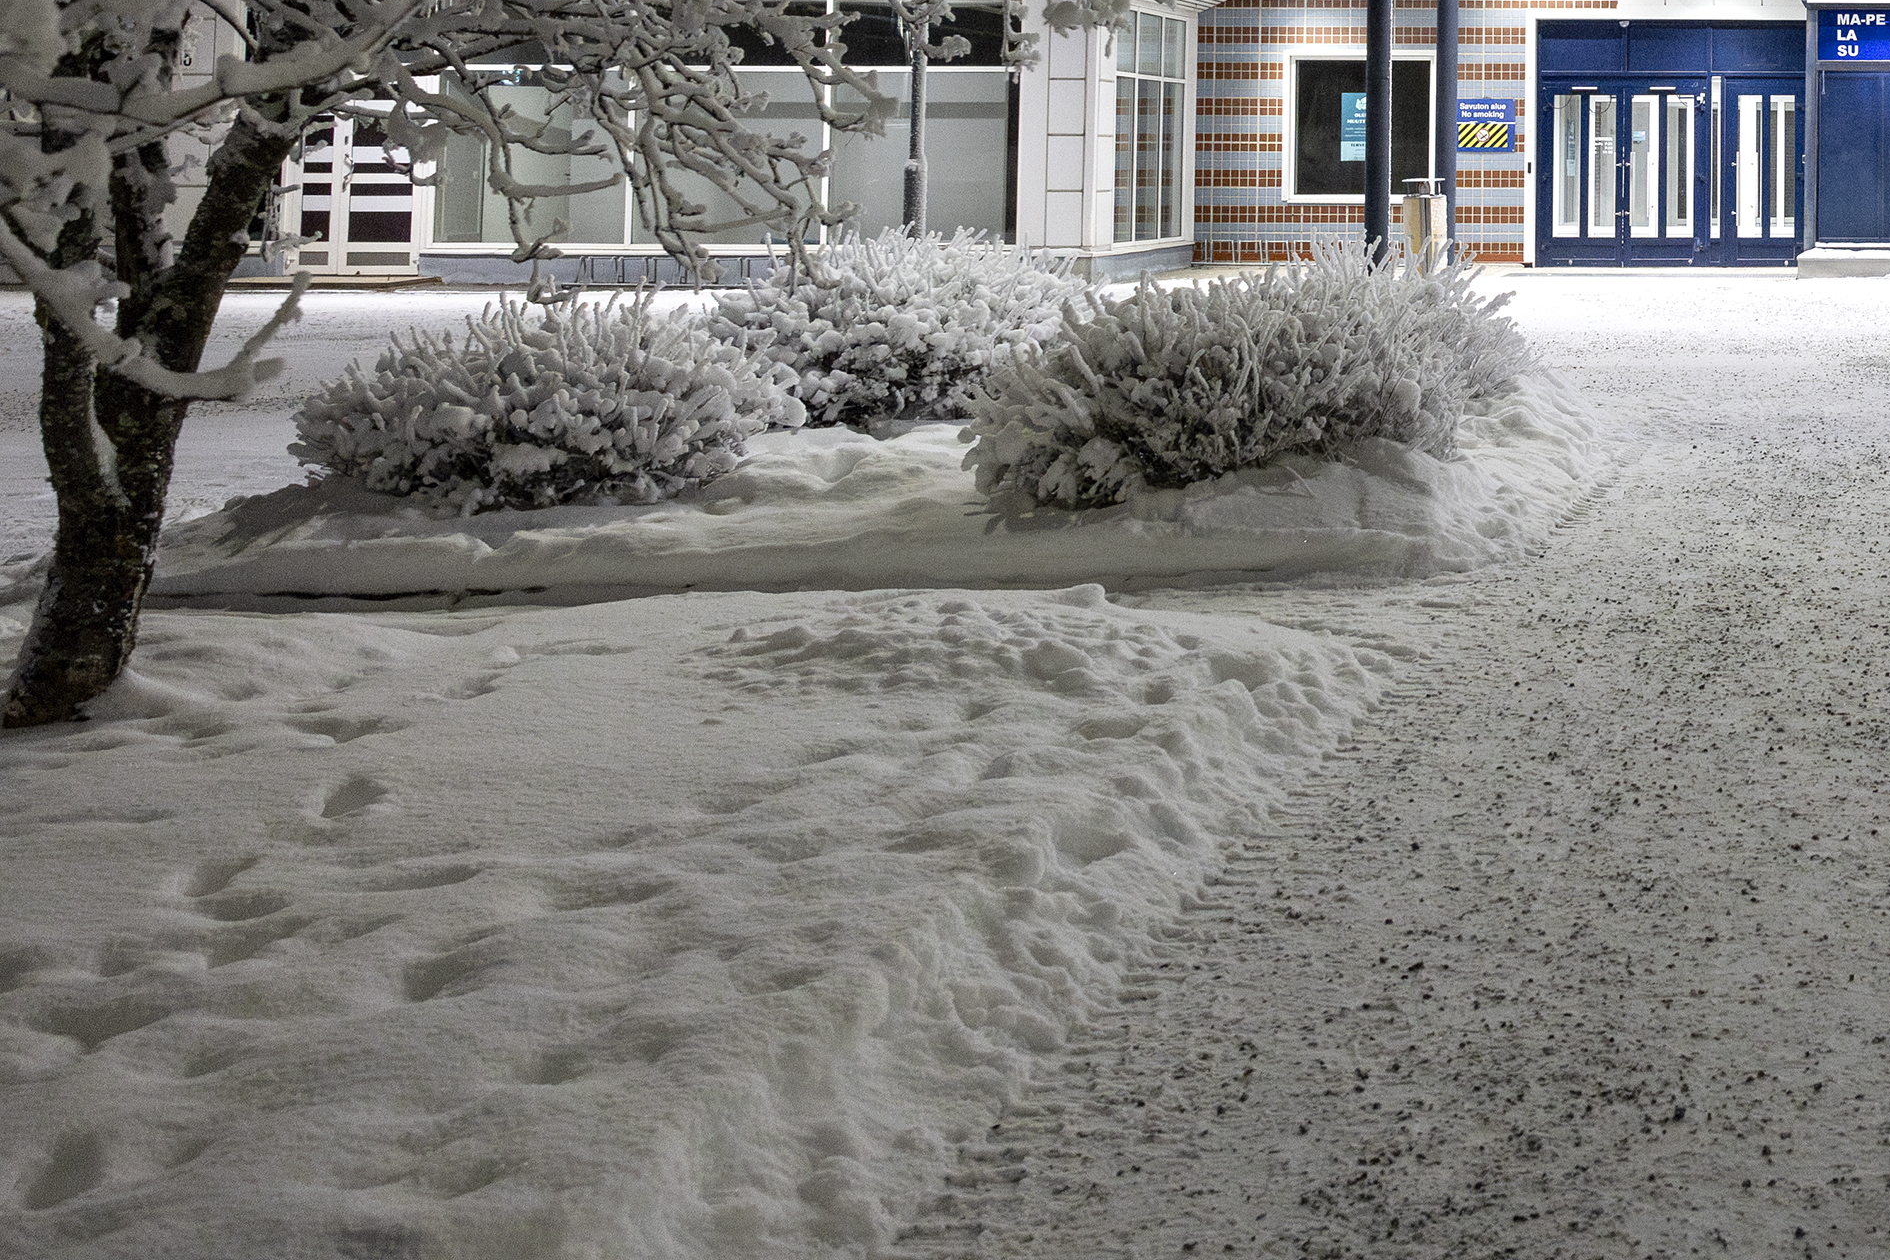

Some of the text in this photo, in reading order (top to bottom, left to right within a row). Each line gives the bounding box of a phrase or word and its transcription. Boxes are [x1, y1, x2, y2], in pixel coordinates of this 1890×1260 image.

[1836, 13, 1886, 26] MA-PE
[1836, 29, 1858, 41] LA
[1837, 44, 1859, 57] SU
[1459, 102, 1507, 110] Savuton alue
[1461, 110, 1505, 120] No smoking
